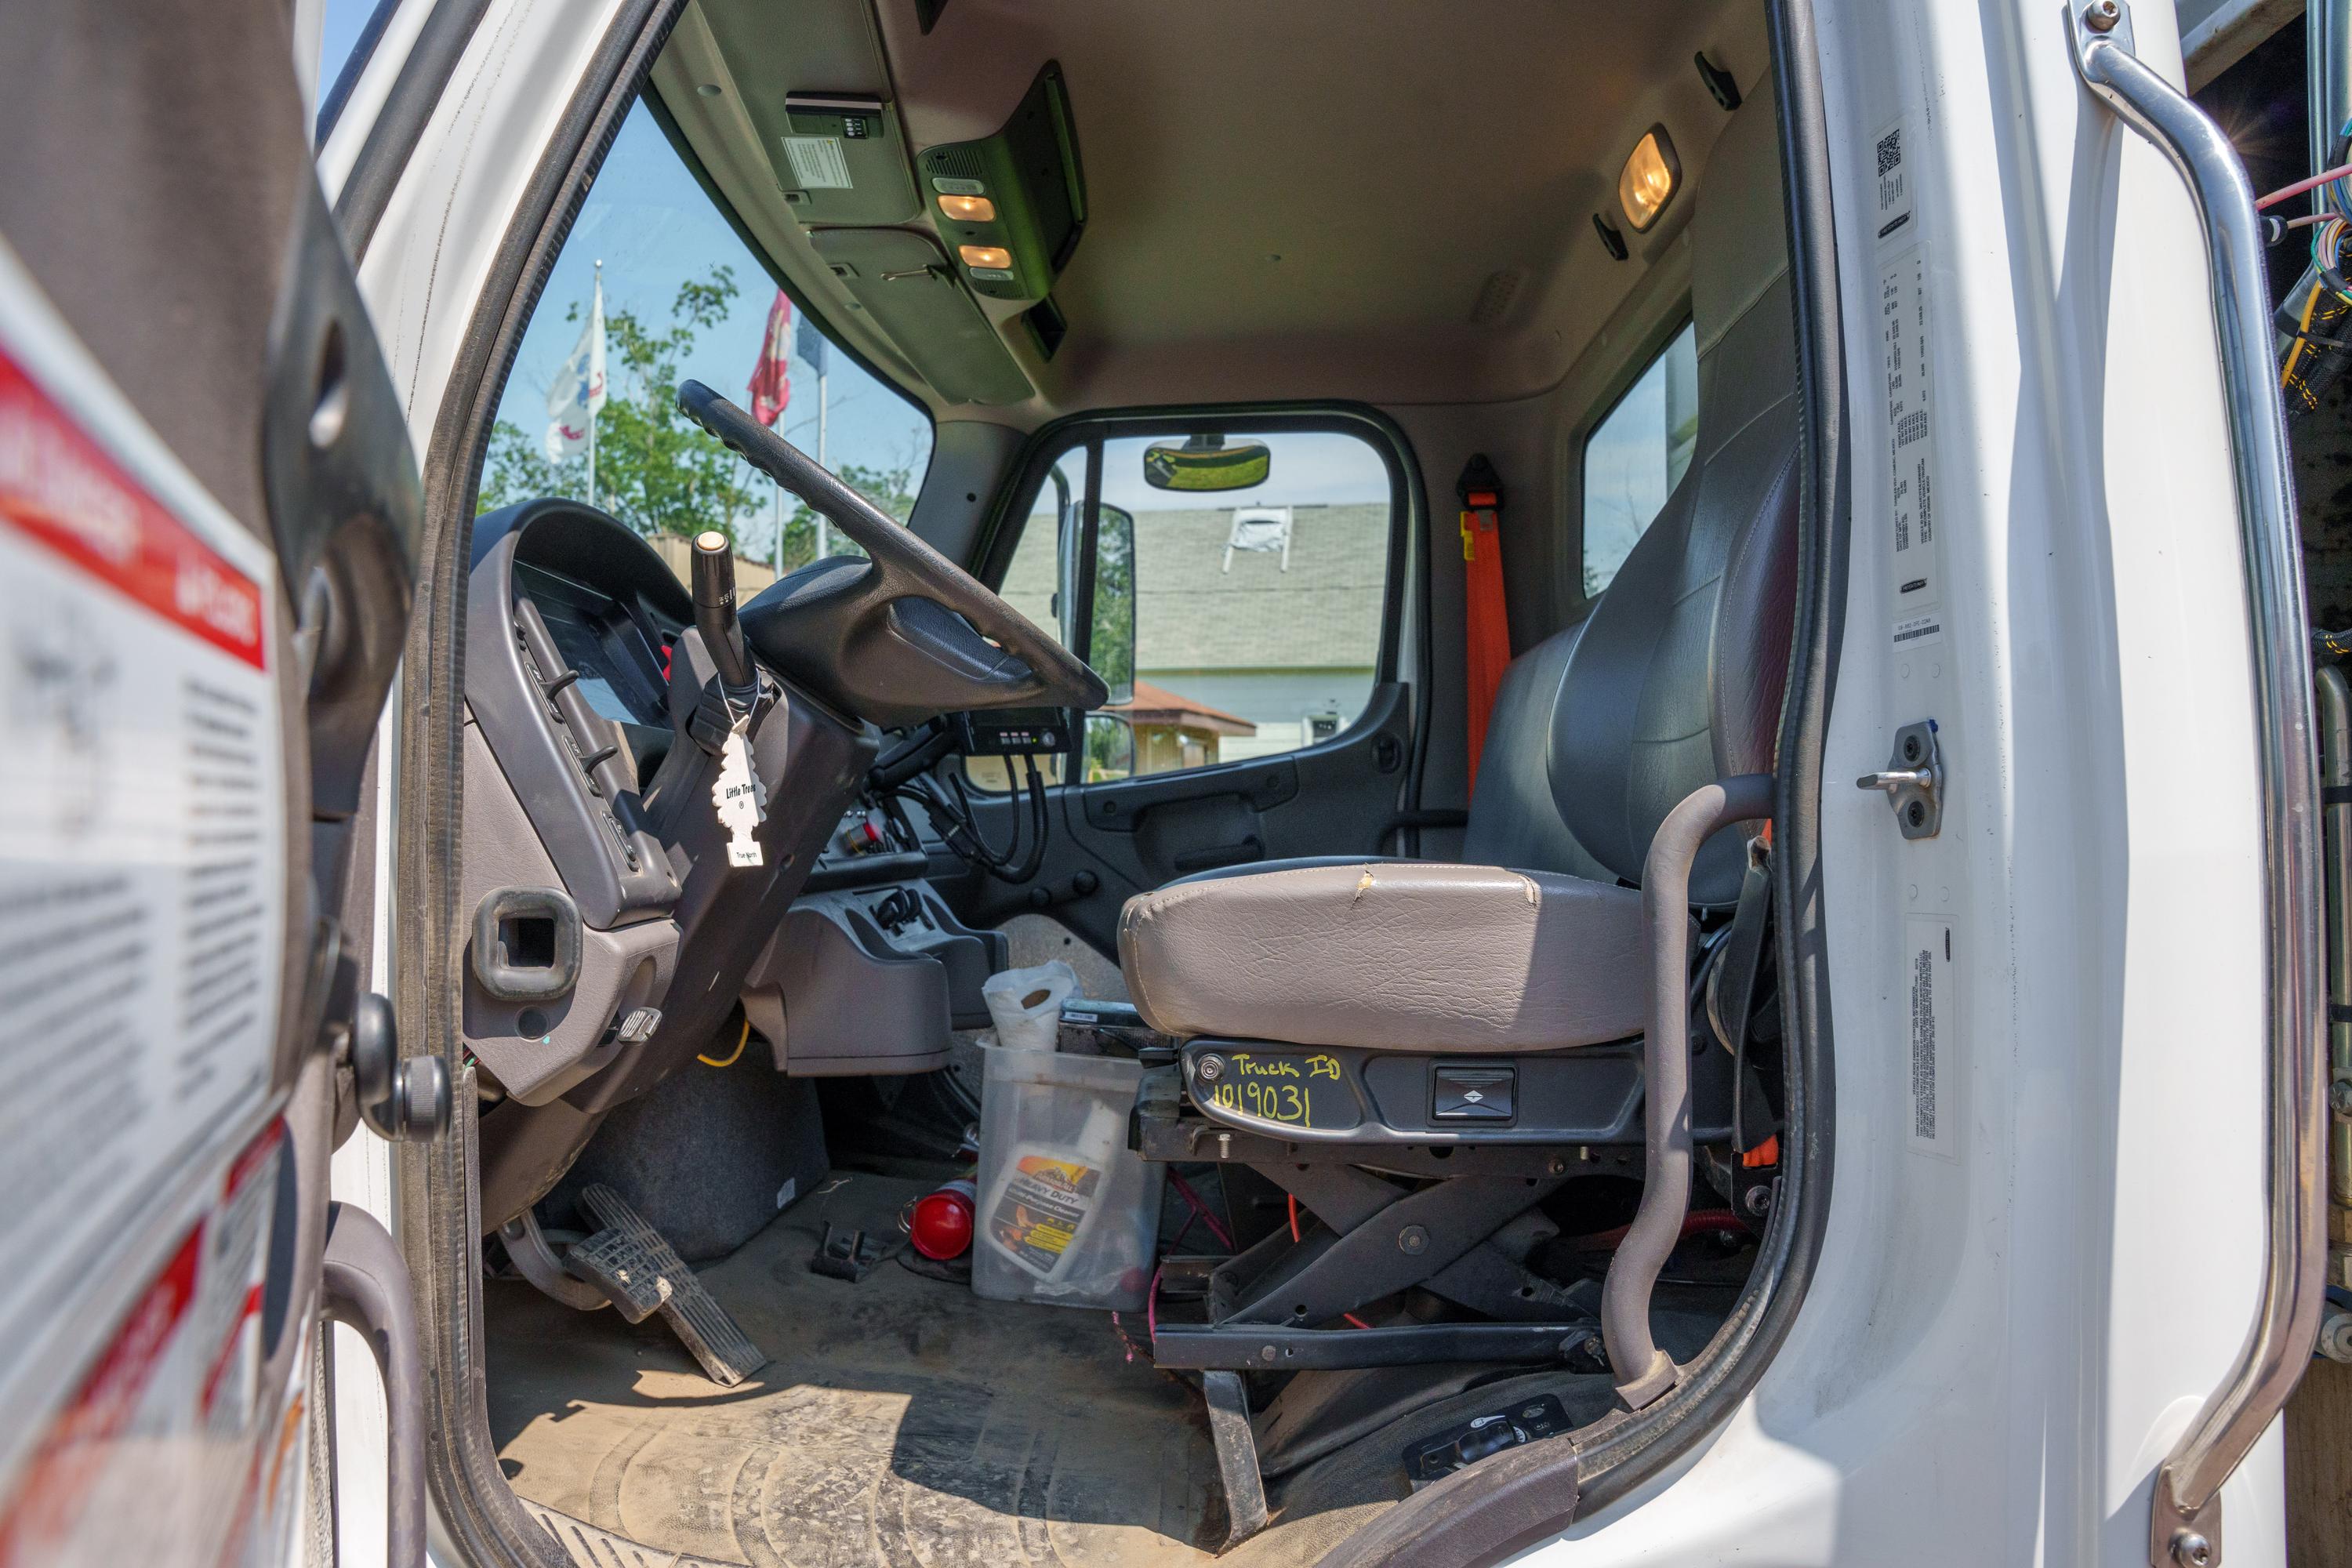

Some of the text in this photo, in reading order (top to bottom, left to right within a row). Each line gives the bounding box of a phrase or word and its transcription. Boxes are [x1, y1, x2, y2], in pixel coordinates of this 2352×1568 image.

[726, 784, 757, 799] Little Trees
[1232, 1054, 1341, 1080] Truck ID
[1214, 1081, 1311, 1127] 1019031
[1019, 1177, 1079, 1204] HEAVY DUTY
